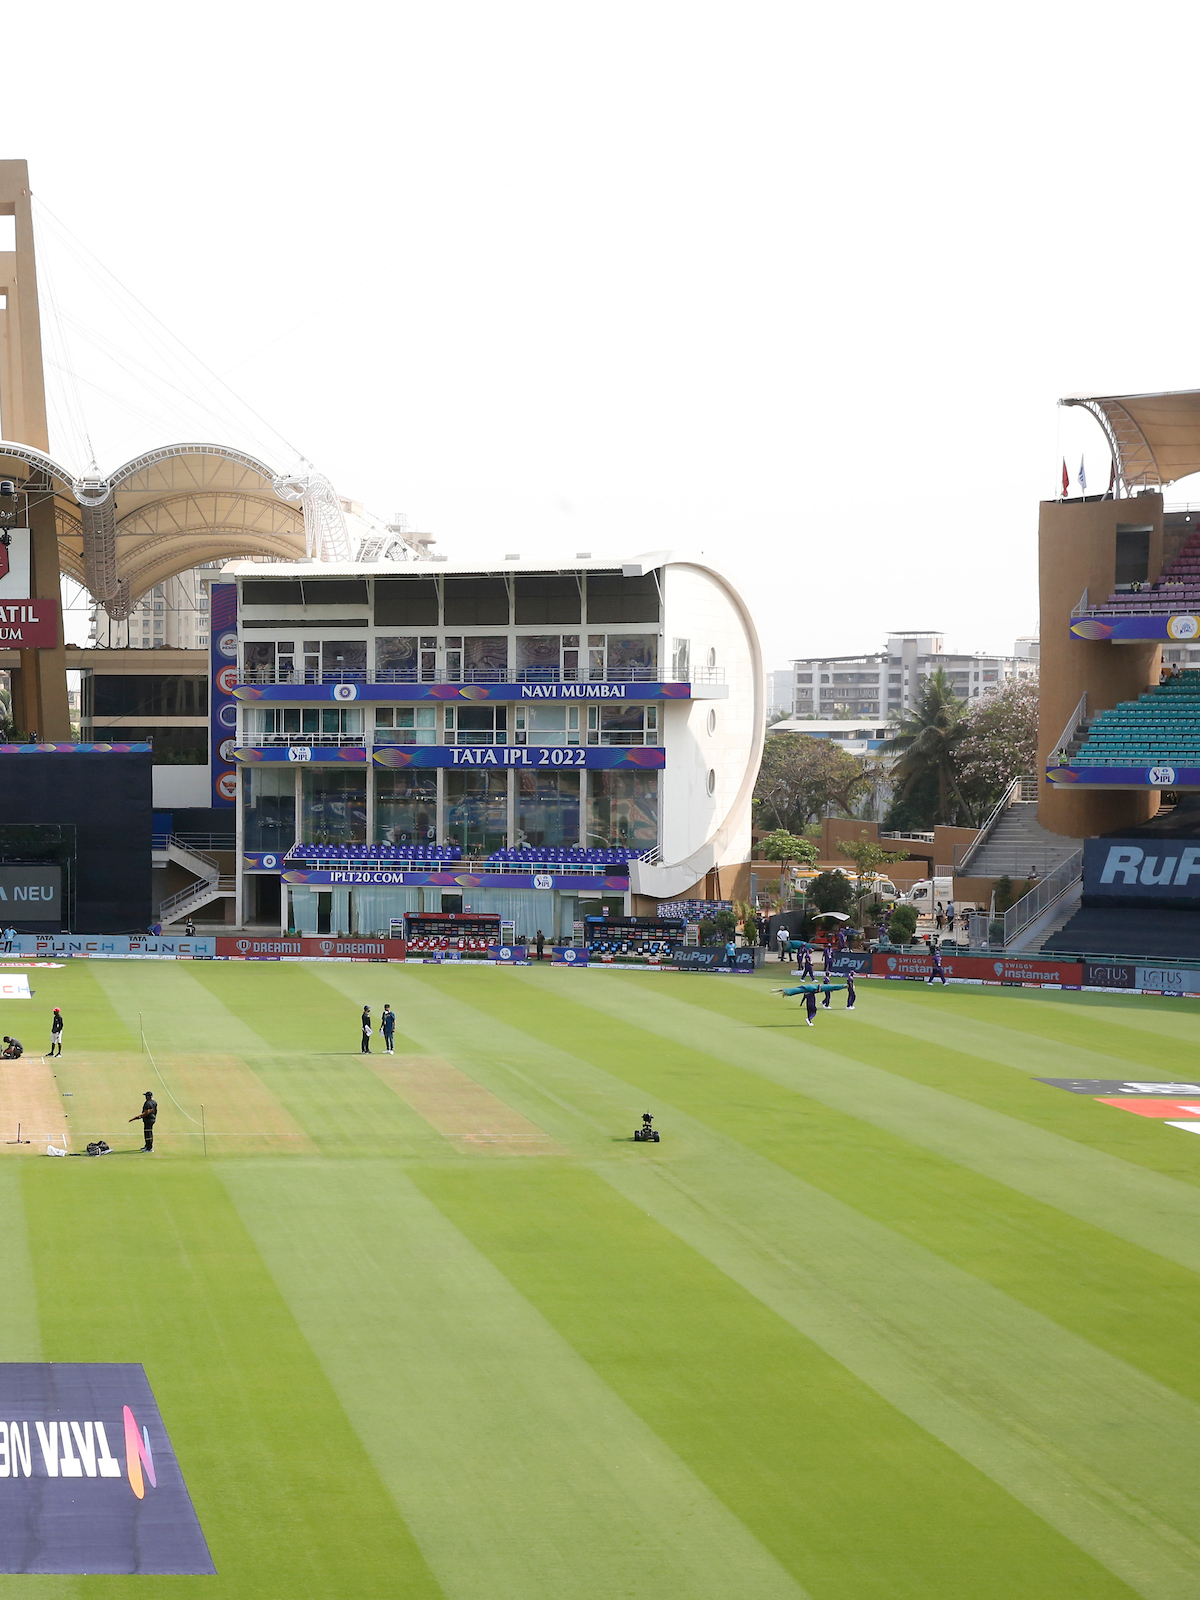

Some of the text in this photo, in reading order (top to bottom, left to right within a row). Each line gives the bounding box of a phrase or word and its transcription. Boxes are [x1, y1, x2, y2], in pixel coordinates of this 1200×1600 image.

[521, 685, 626, 698] NAVI MUMBAI
[449, 749, 587, 765] TATA IPL 2022
[1159, 775, 1171, 783] IPL
[330, 871, 404, 884] IPLT20.COM
[13, 886, 54, 902] NEU
[36, 941, 115, 952] PUNCH
[129, 943, 208, 953] PUNCH
[253, 942, 301, 953] DREAM11
[336, 943, 385, 954] DREAM11
[673, 951, 715, 964] RuPay
[832, 957, 865, 970] uPay
[898, 964, 954, 975] instamrt
[1004, 969, 1060, 981] instamart
[1089, 966, 1128, 981] LOTUS
[1143, 970, 1182, 984] LOTUS
[35, 1420, 122, 1478] TATA
